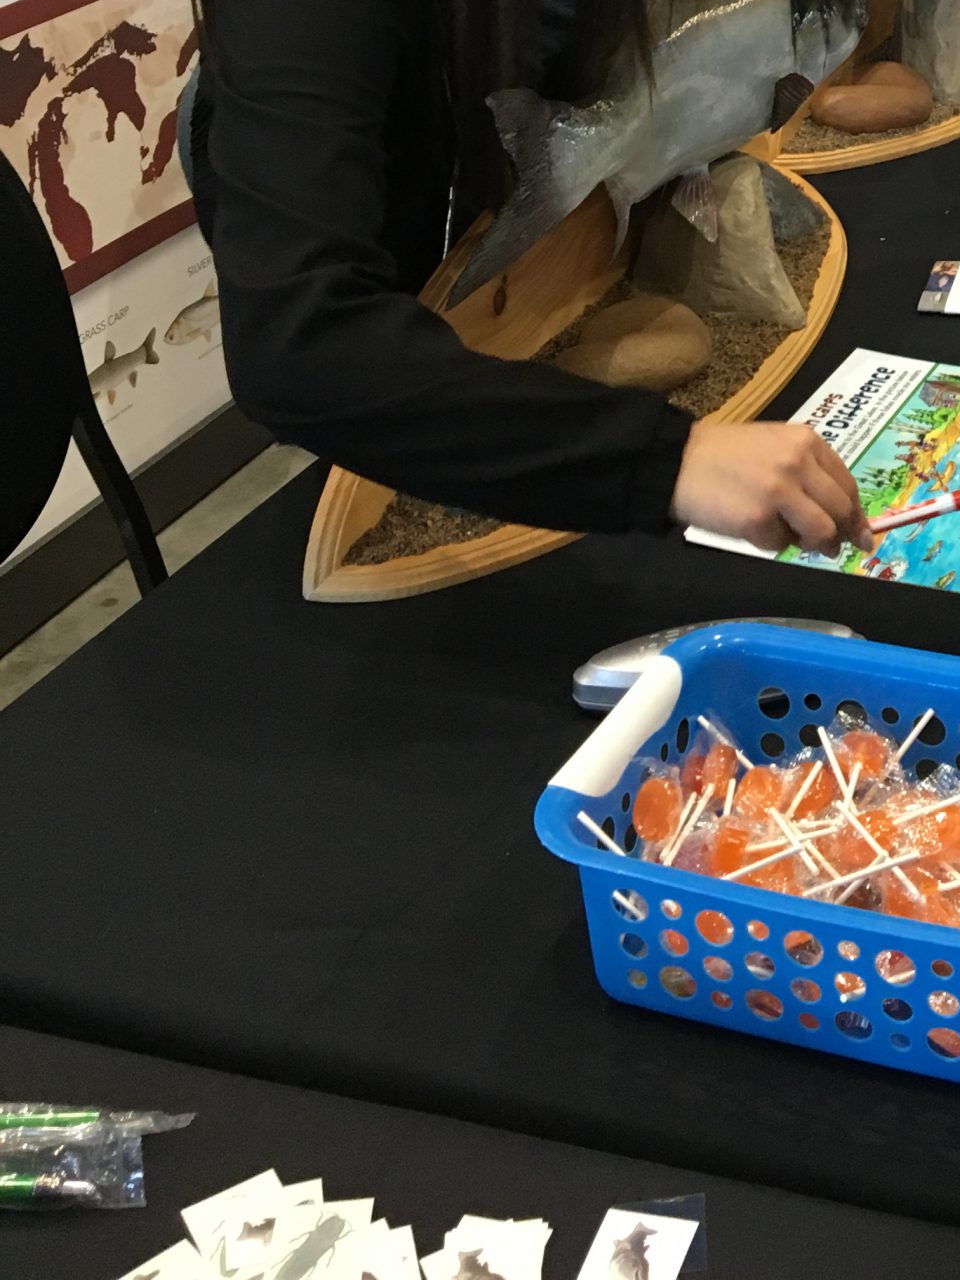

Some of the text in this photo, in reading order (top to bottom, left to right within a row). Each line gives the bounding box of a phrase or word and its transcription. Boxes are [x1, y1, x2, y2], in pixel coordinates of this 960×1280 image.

[187, 255, 213, 278] SILVER
[79, 304, 130, 345] GRASS CARP
[811, 392, 844, 419] carps
[825, 366, 896, 430] Difference
